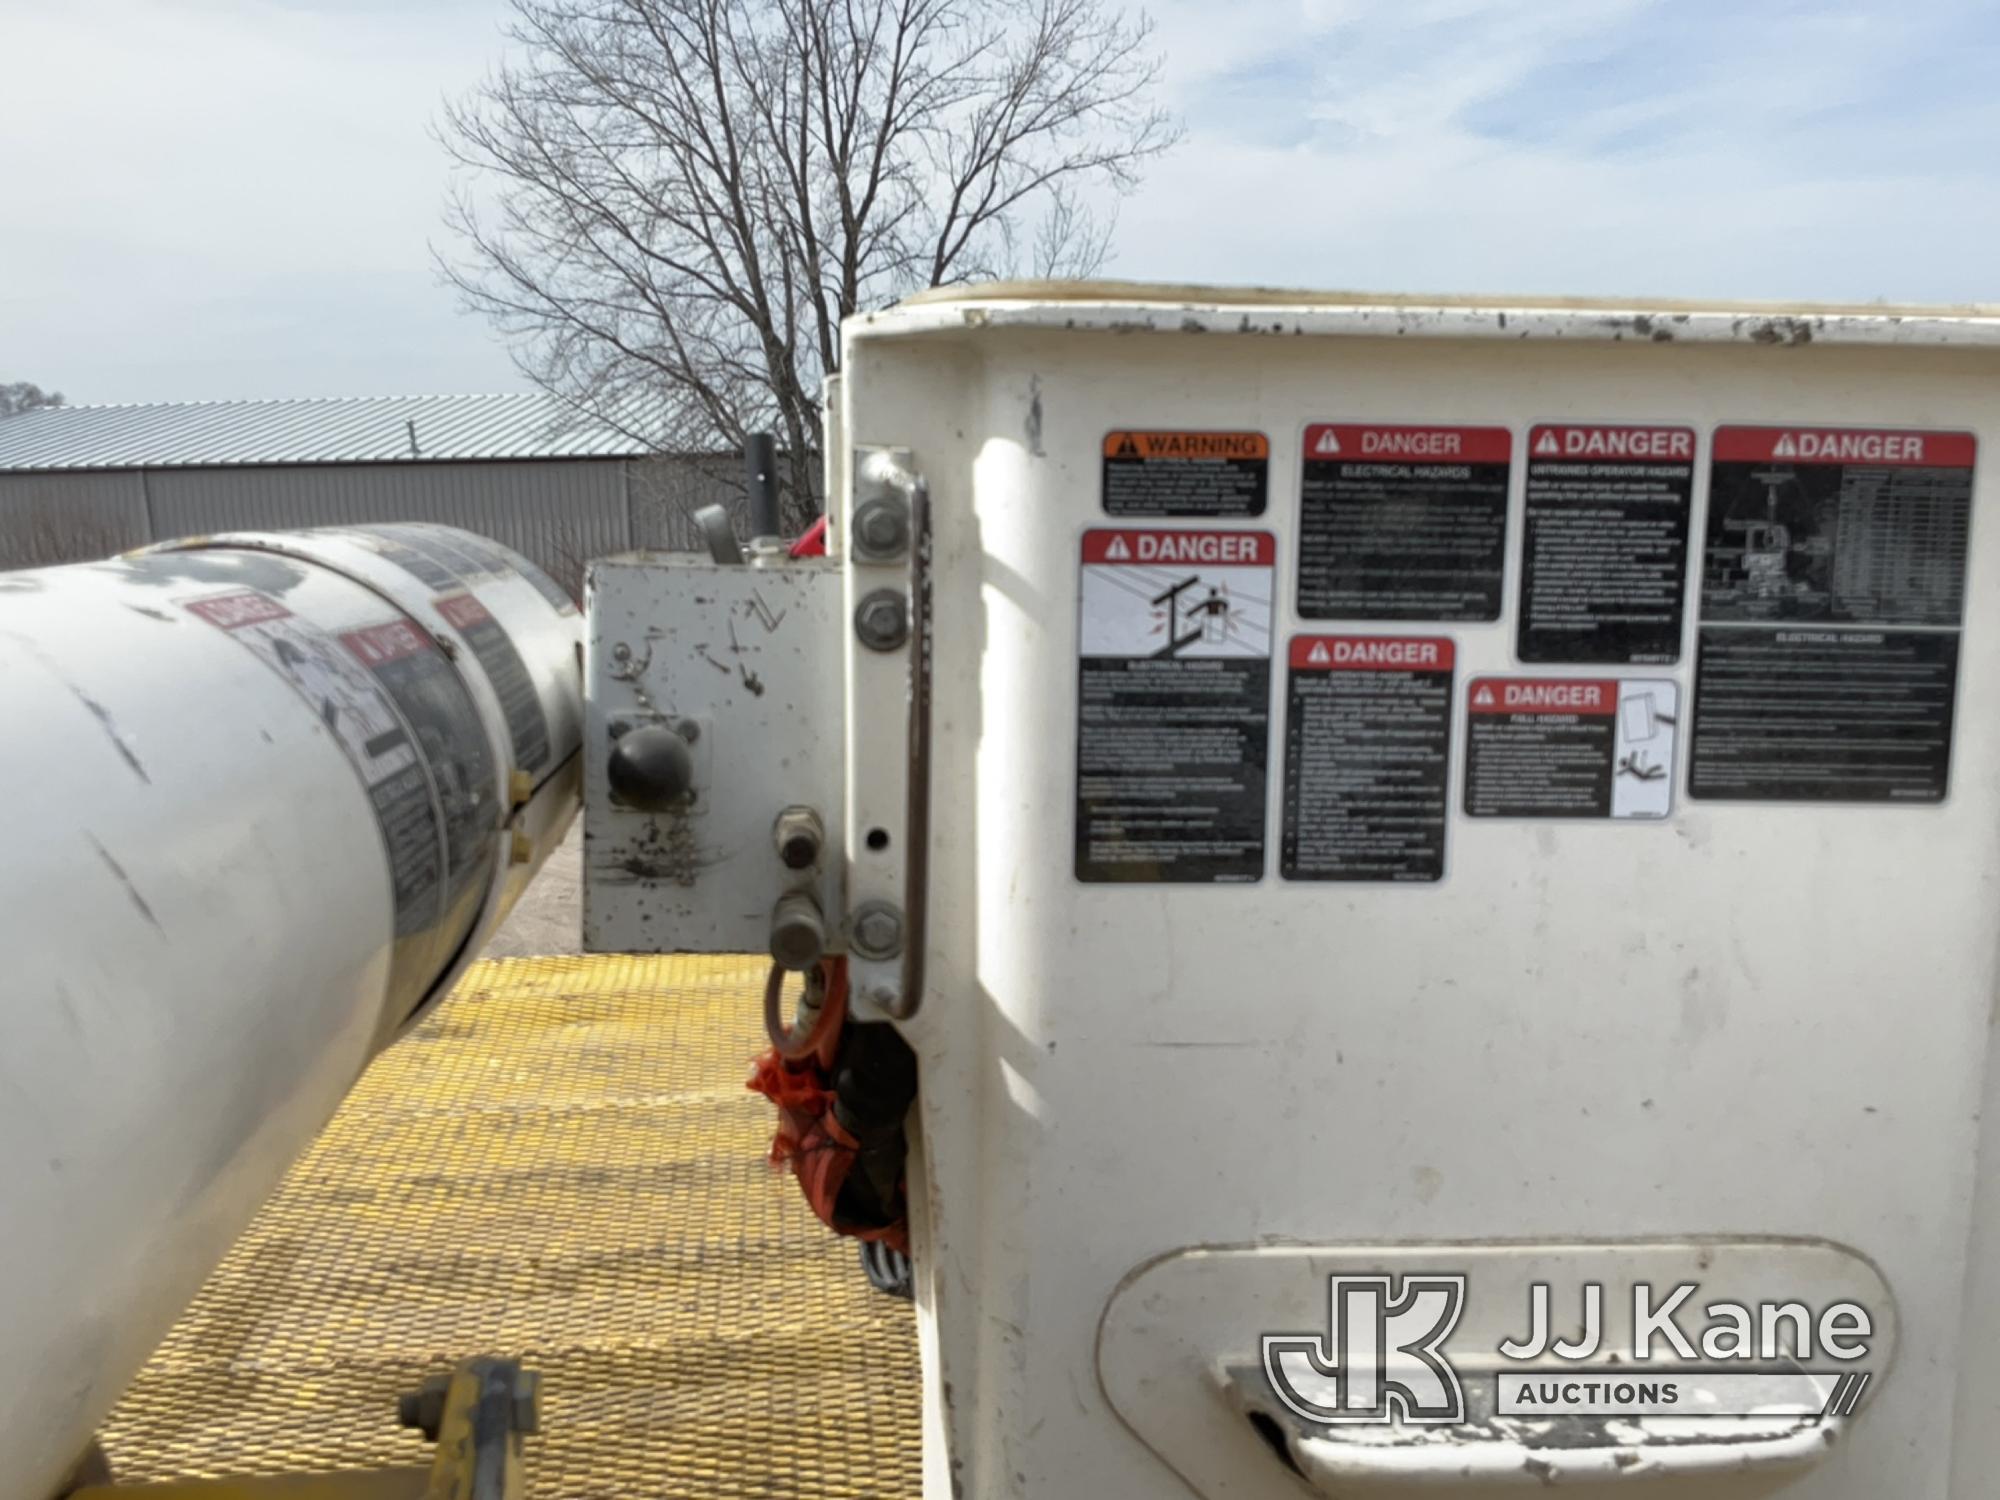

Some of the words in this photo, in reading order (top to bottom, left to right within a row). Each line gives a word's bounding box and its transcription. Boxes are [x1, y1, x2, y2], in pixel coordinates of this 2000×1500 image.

[1147, 436, 1257, 454] WARNING
[1362, 432, 1461, 454] DANGER
[1565, 429, 1690, 455] DANGER
[1800, 433, 1923, 460] DANGER
[1340, 464, 1412, 478] ELECTRICAL
[1137, 534, 1258, 560] DANGER
[1334, 642, 1437, 663] DANGER
[1505, 685, 1600, 706] DANGER
